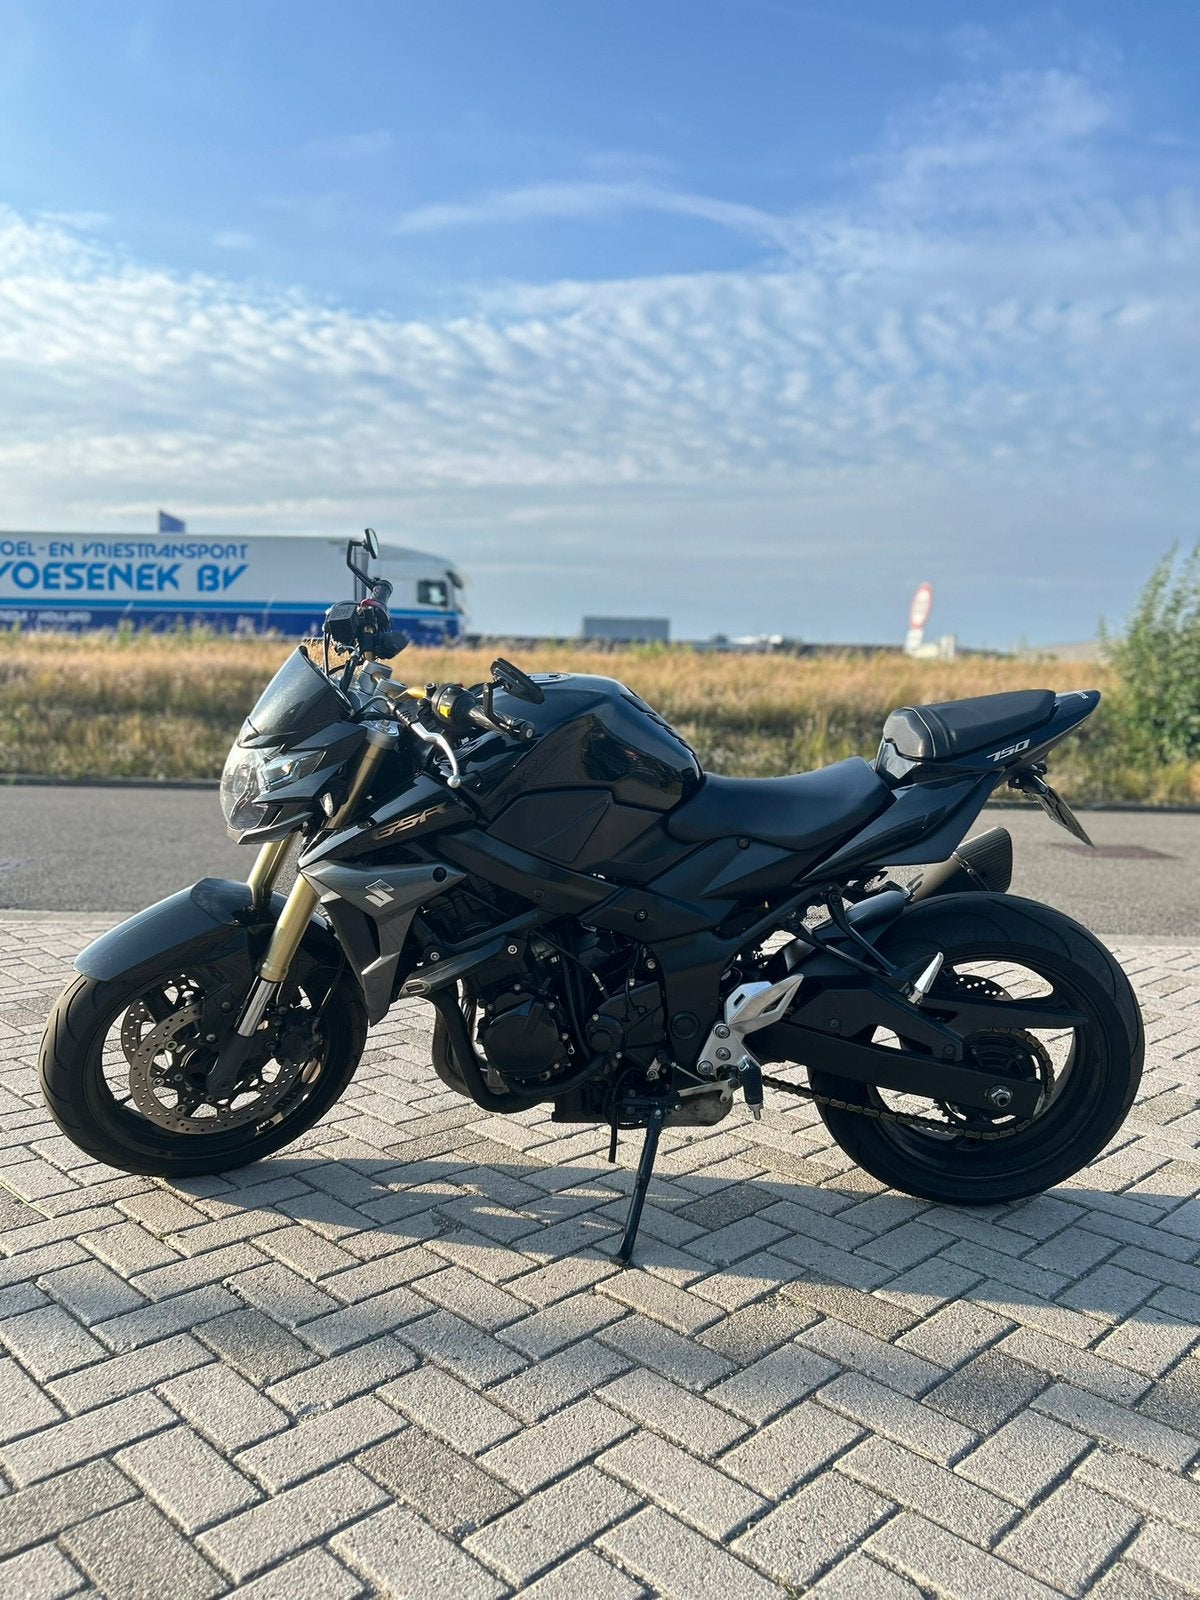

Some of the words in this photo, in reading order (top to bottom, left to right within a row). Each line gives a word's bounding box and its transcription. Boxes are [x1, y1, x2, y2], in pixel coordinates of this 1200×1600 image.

[82, 542, 249, 560] VRIESTRANSPORT
[197, 563, 250, 592] BV
[986, 739, 1030, 762] 750
[373, 802, 448, 840] GSR
